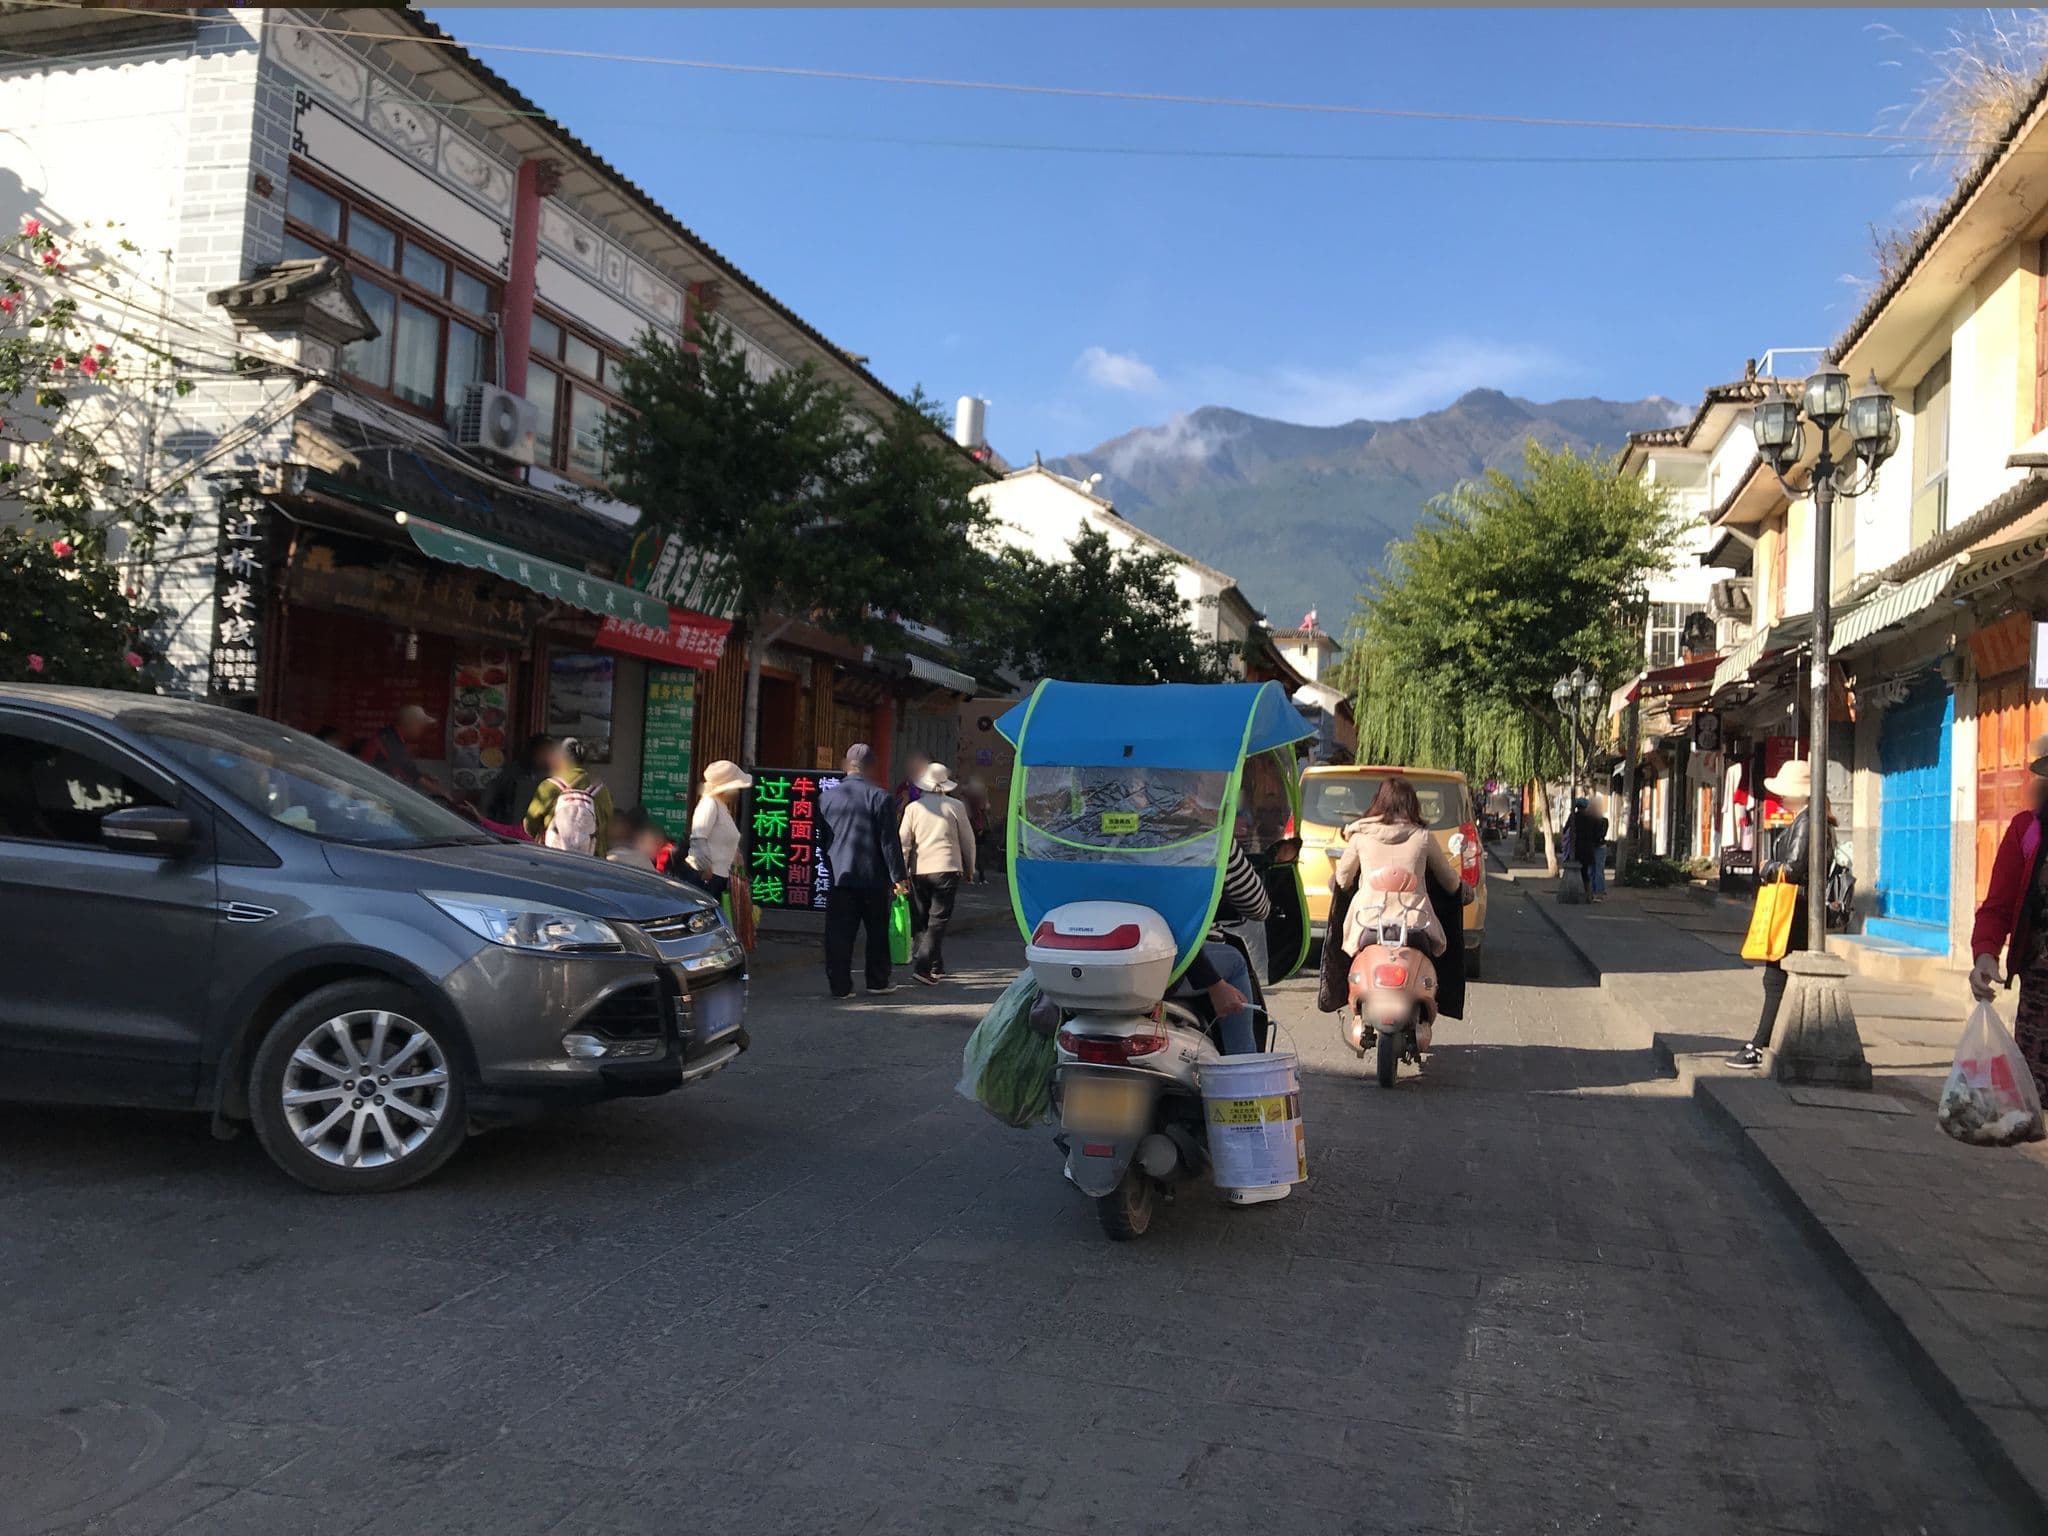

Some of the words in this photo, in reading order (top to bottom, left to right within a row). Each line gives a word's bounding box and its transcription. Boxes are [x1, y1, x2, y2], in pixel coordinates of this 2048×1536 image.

[219, 514, 263, 647] 过桥米线
[752, 776, 791, 903] 过桥米线
[787, 777, 816, 906] 牛肉面刀削面
